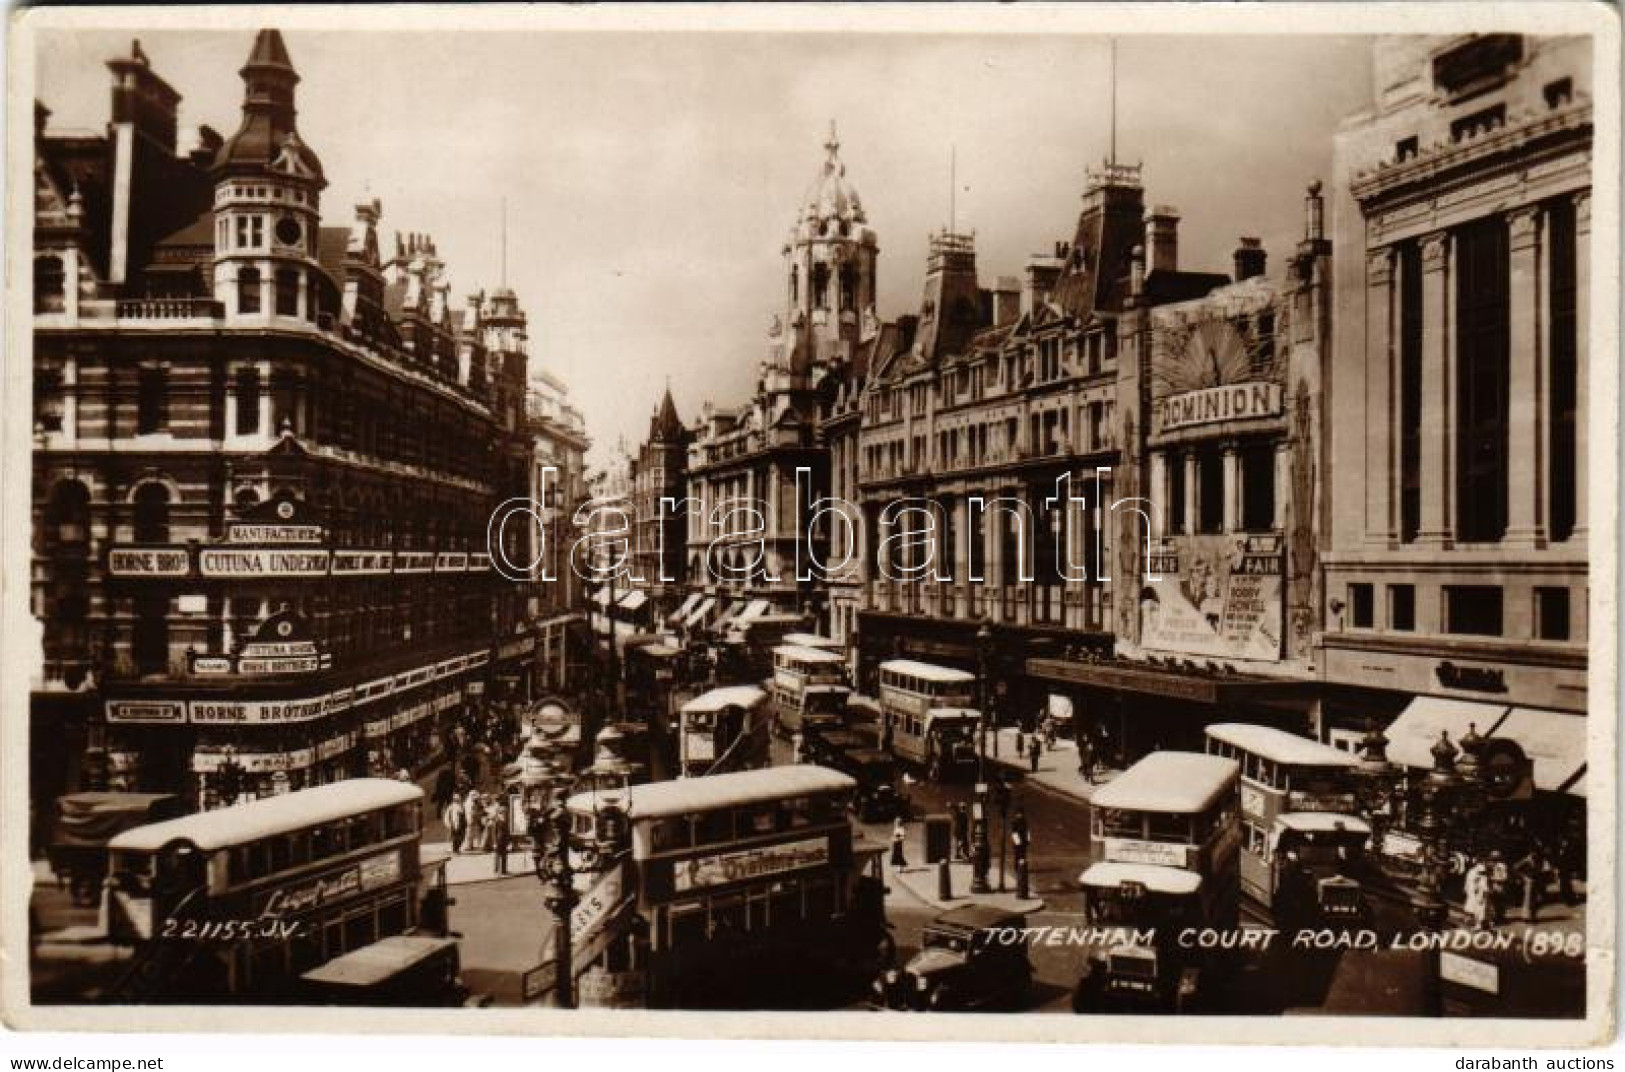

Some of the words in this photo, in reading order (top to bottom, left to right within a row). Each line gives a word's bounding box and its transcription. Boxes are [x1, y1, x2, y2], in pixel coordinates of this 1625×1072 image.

[1163, 383, 1271, 428] DOMINION
[113, 553, 153, 572] HORNE
[194, 706, 247, 720] HORNE
